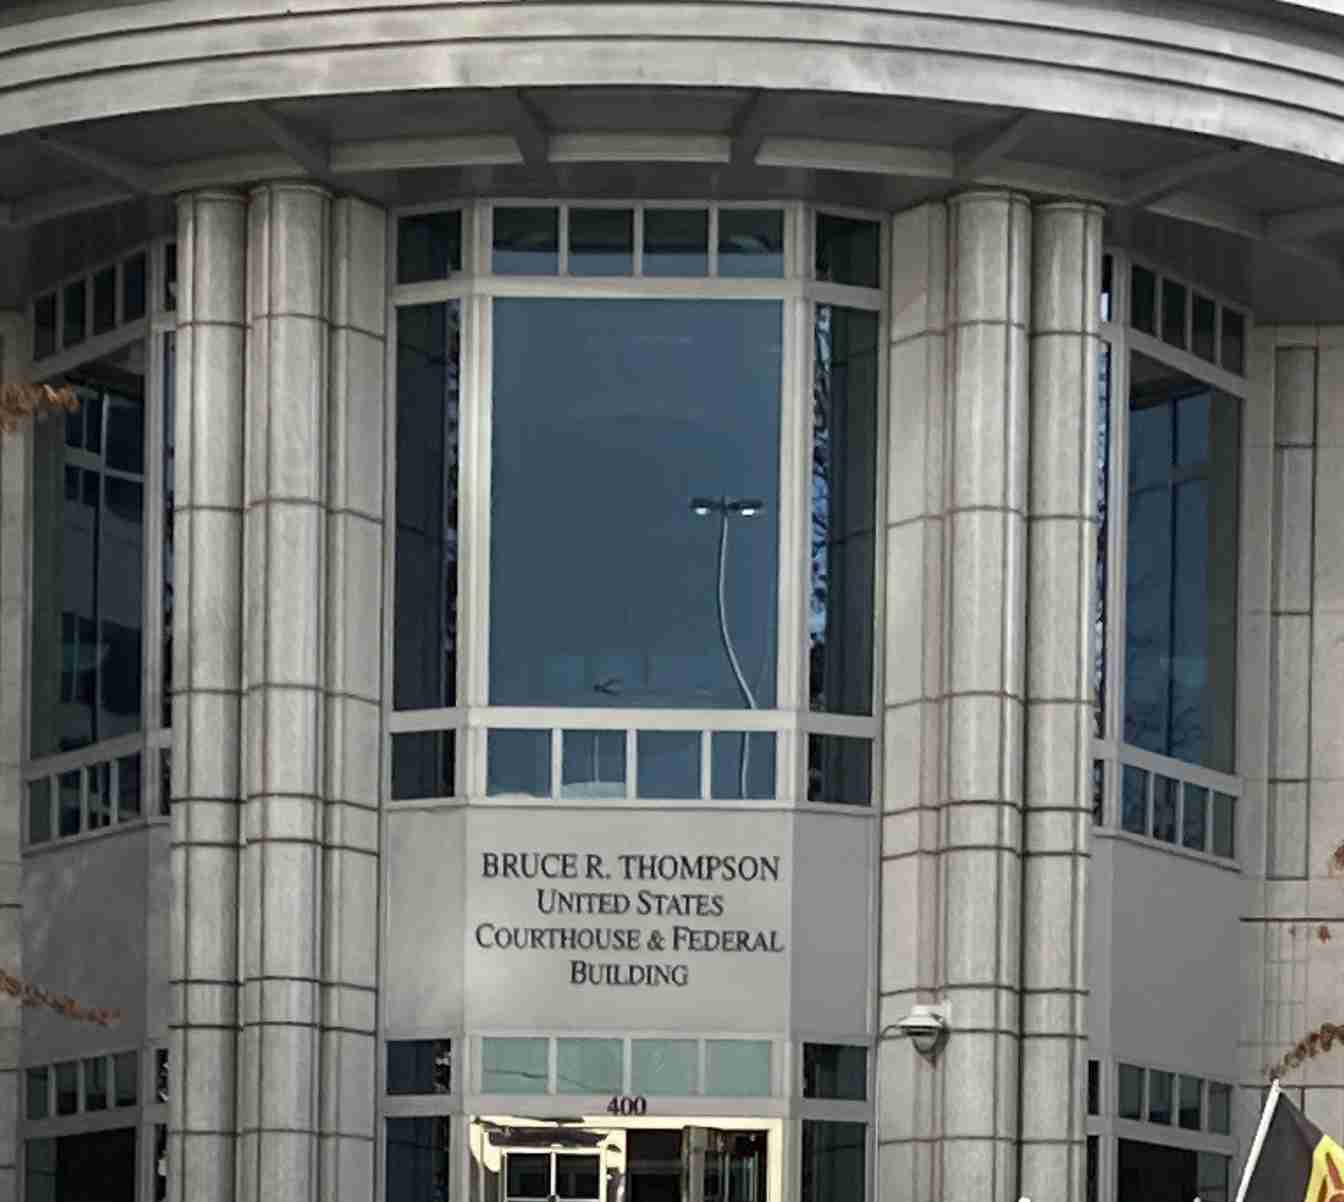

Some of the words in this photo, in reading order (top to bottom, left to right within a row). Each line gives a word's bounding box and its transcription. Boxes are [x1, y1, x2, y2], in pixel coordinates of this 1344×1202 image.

[481, 852, 577, 879] BRUCE
[585, 853, 610, 880] R.
[618, 854, 781, 881] THOMPSON
[536, 888, 631, 915] UNITED
[636, 889, 724, 916] STATES
[475, 922, 641, 950] COURTHOUSE
[647, 929, 664, 951] &
[672, 925, 784, 952] FEDERAL
[570, 960, 689, 987] BUILDING
[607, 1095, 647, 1116] 400
